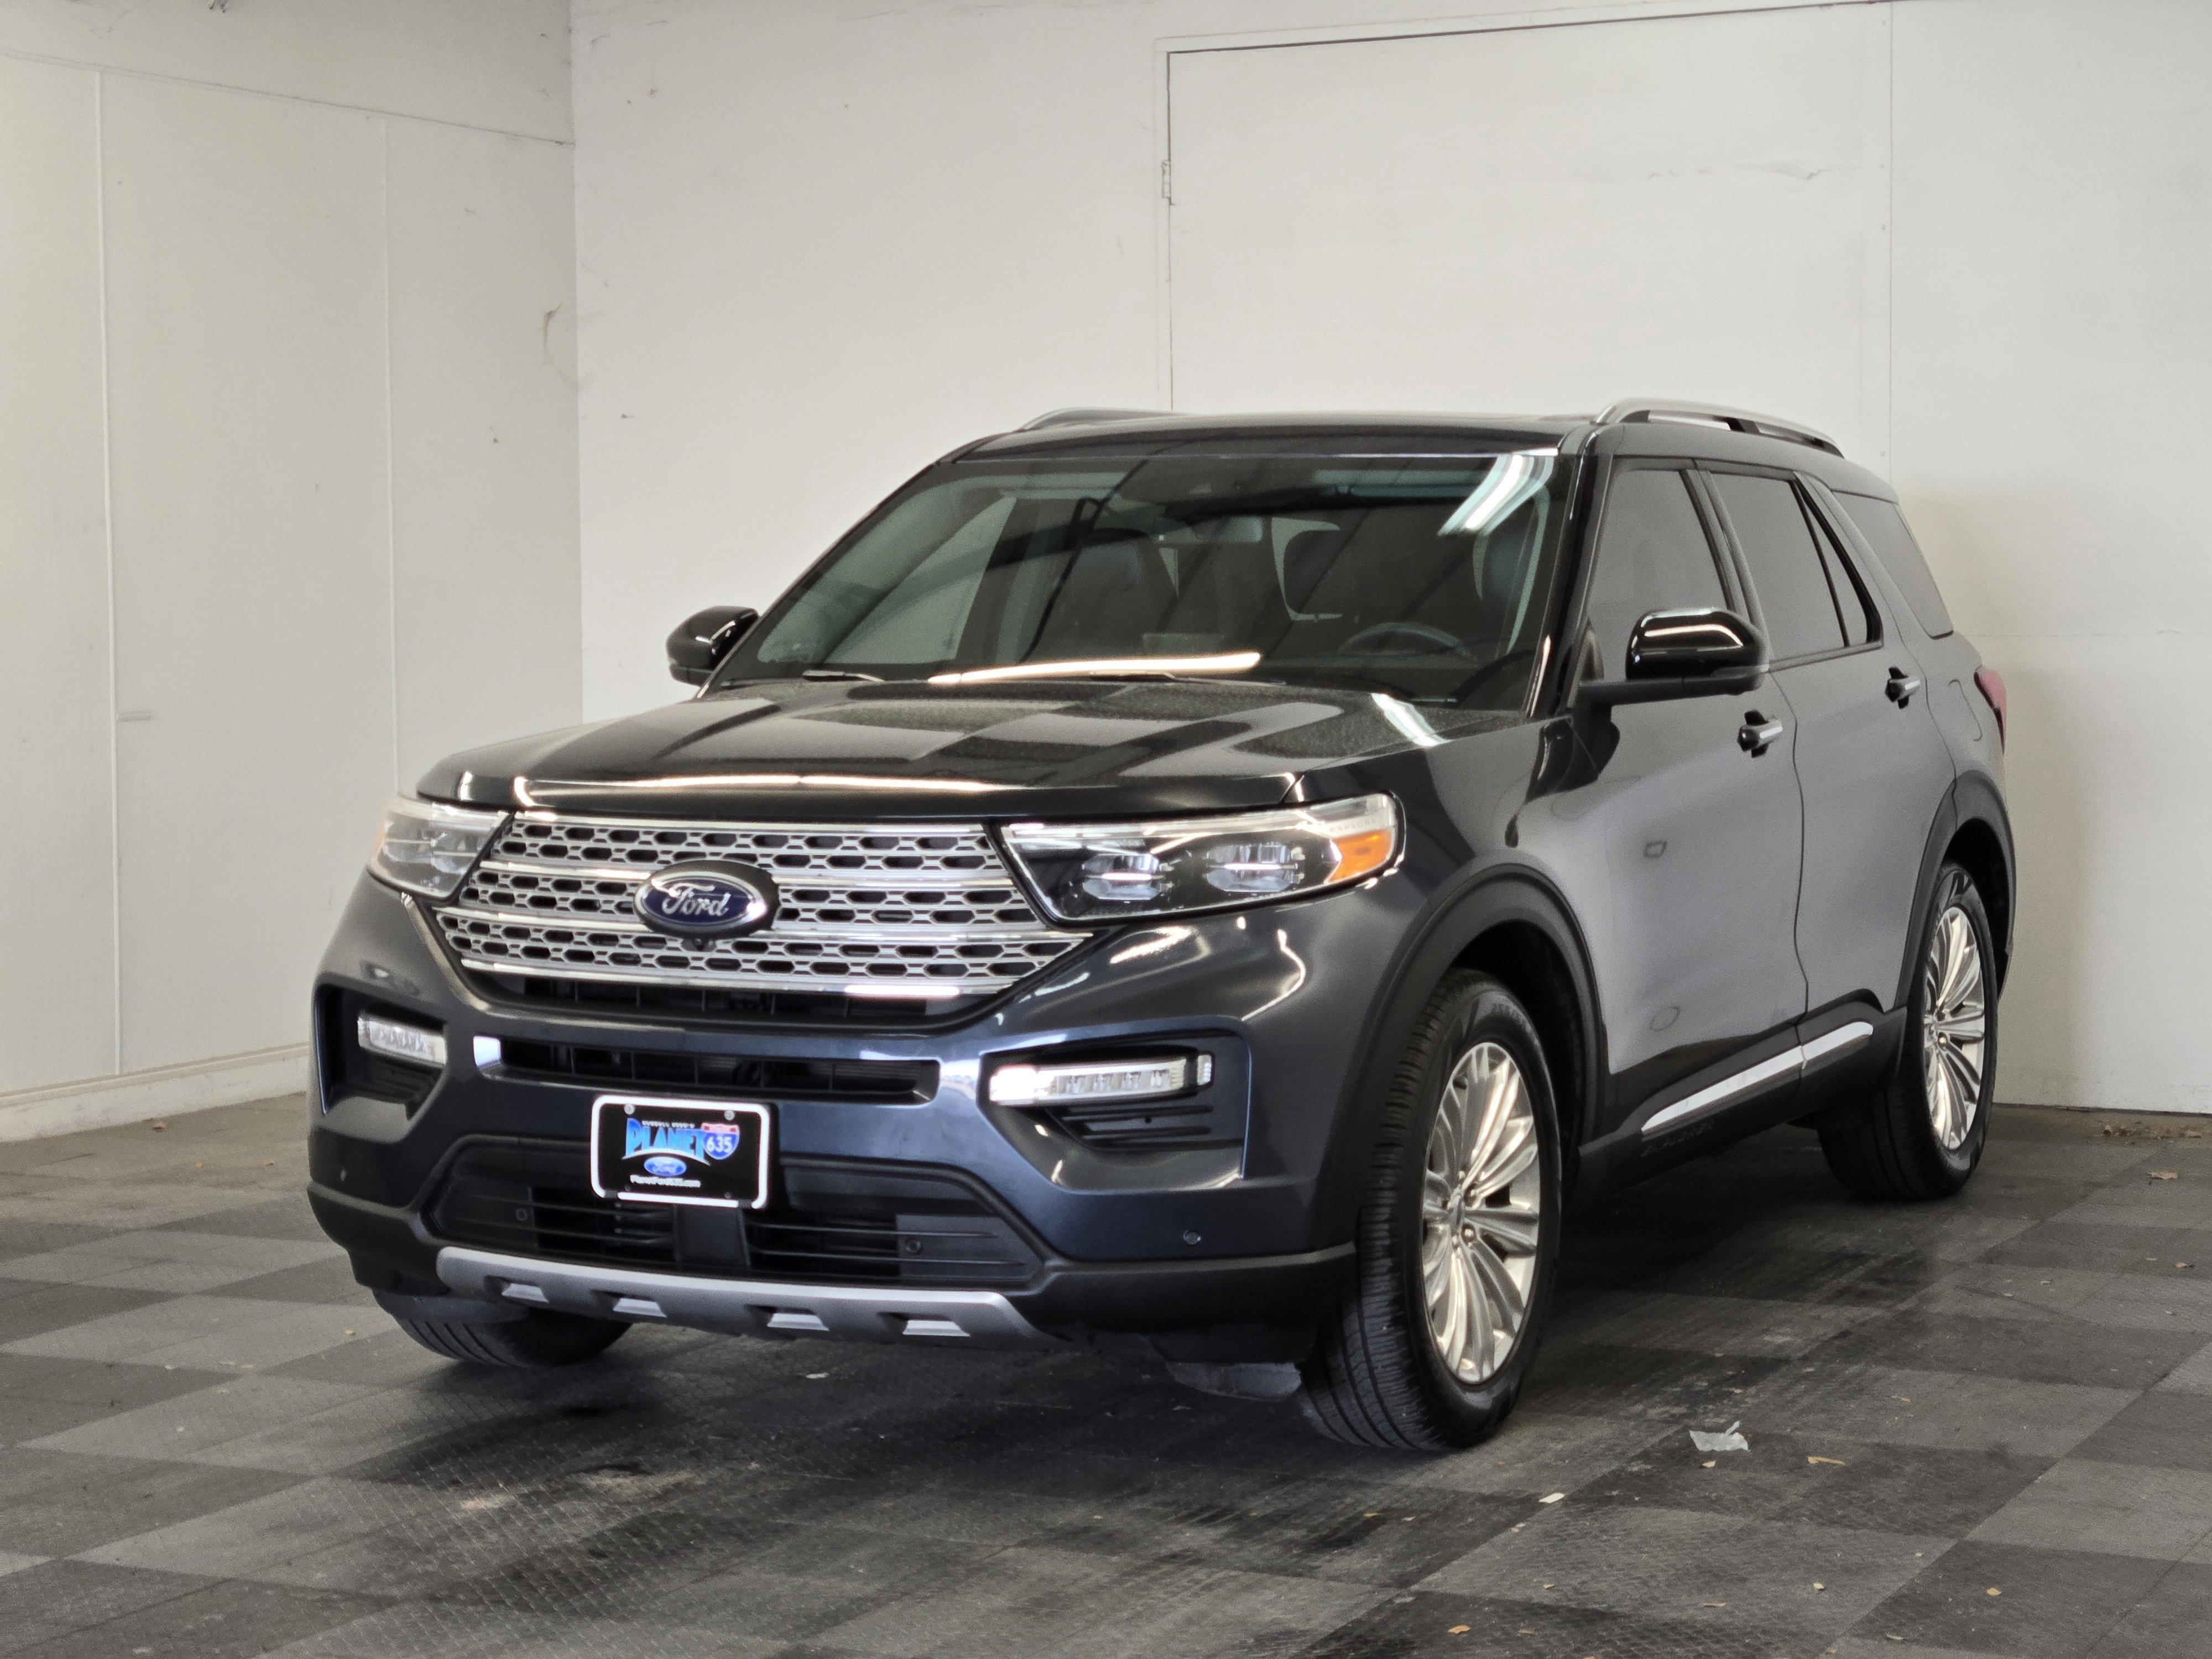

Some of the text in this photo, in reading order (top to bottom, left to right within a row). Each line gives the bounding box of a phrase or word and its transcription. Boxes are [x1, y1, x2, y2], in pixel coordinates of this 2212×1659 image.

[661, 883, 731, 916] Ford
[625, 1117, 708, 1160] PLANET
[707, 1136, 733, 1153] 635
